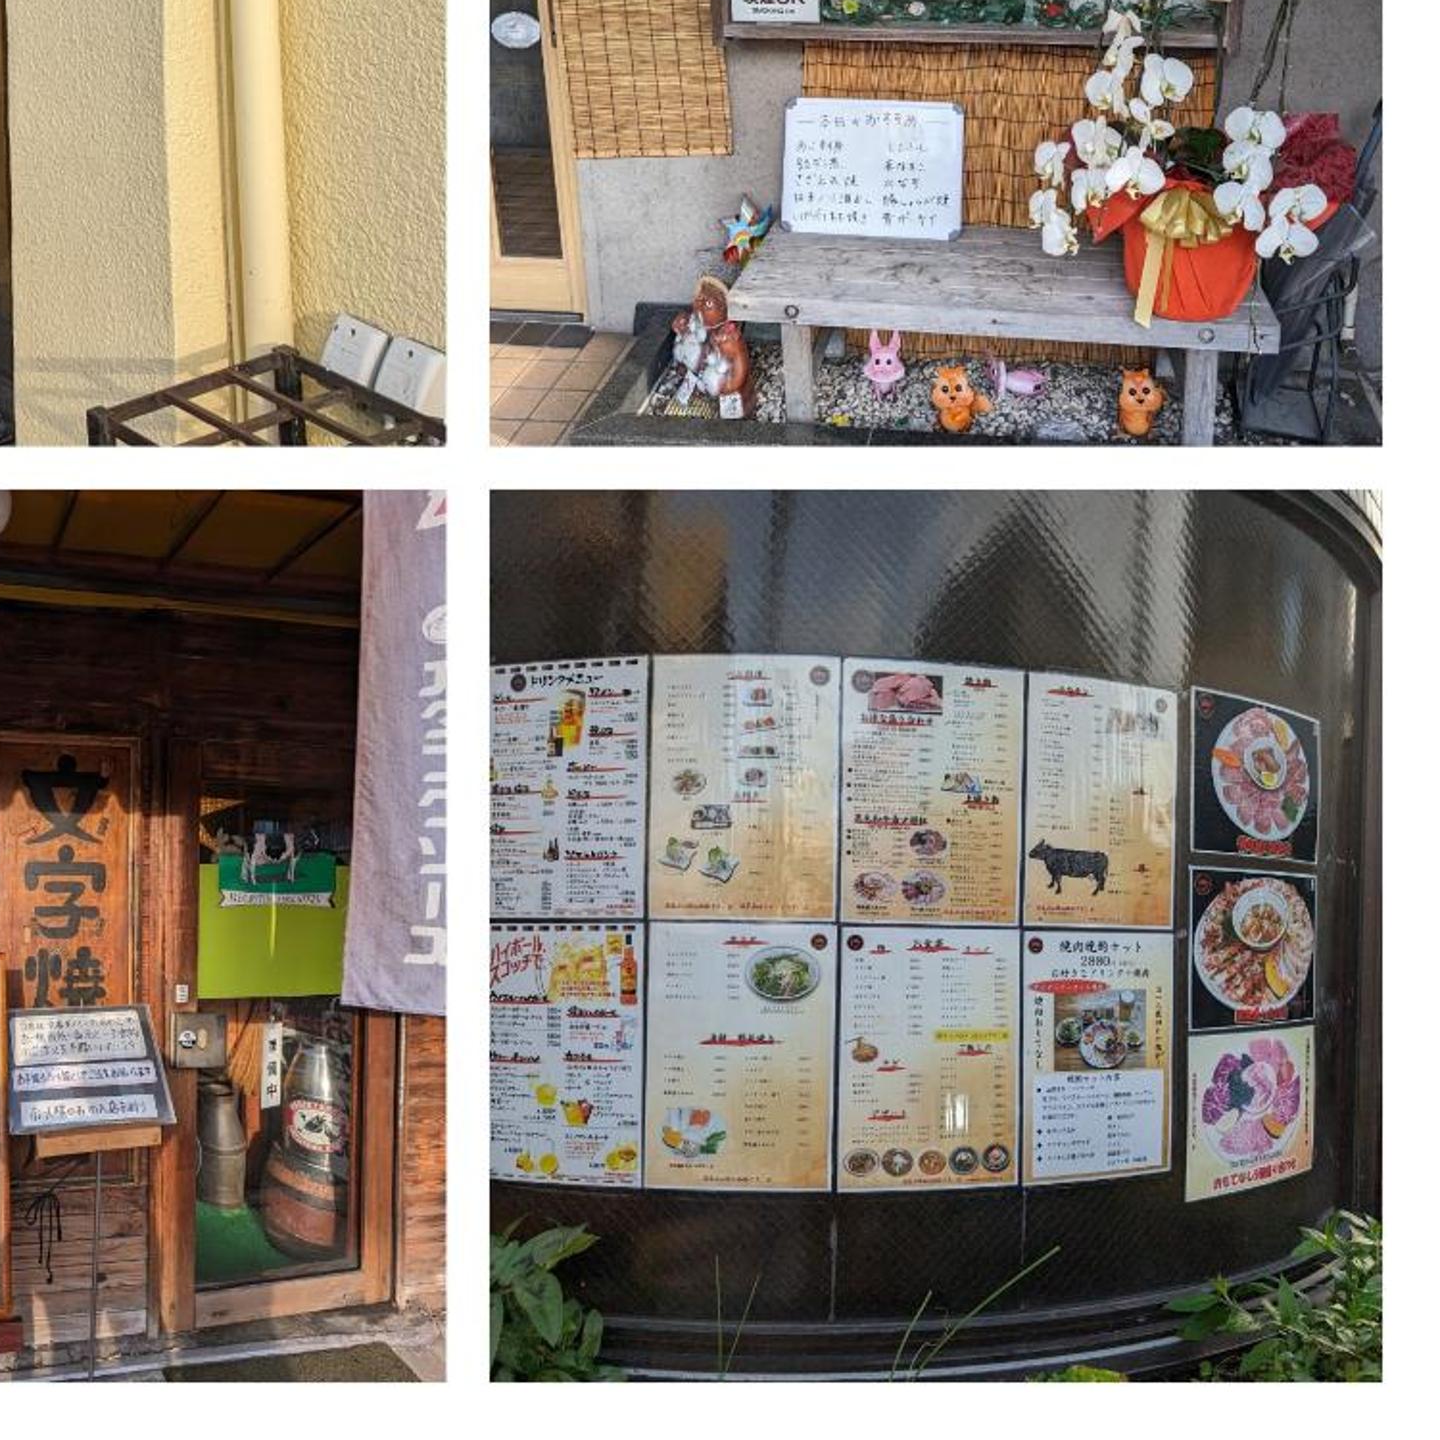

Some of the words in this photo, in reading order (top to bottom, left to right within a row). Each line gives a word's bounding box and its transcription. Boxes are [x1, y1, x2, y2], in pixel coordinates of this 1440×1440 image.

[530, 673, 604, 686] ドリンクメニュー
[1060, 940, 1142, 954] 焼肉晩酌セット
[1080, 955, 1111, 967] 2880
